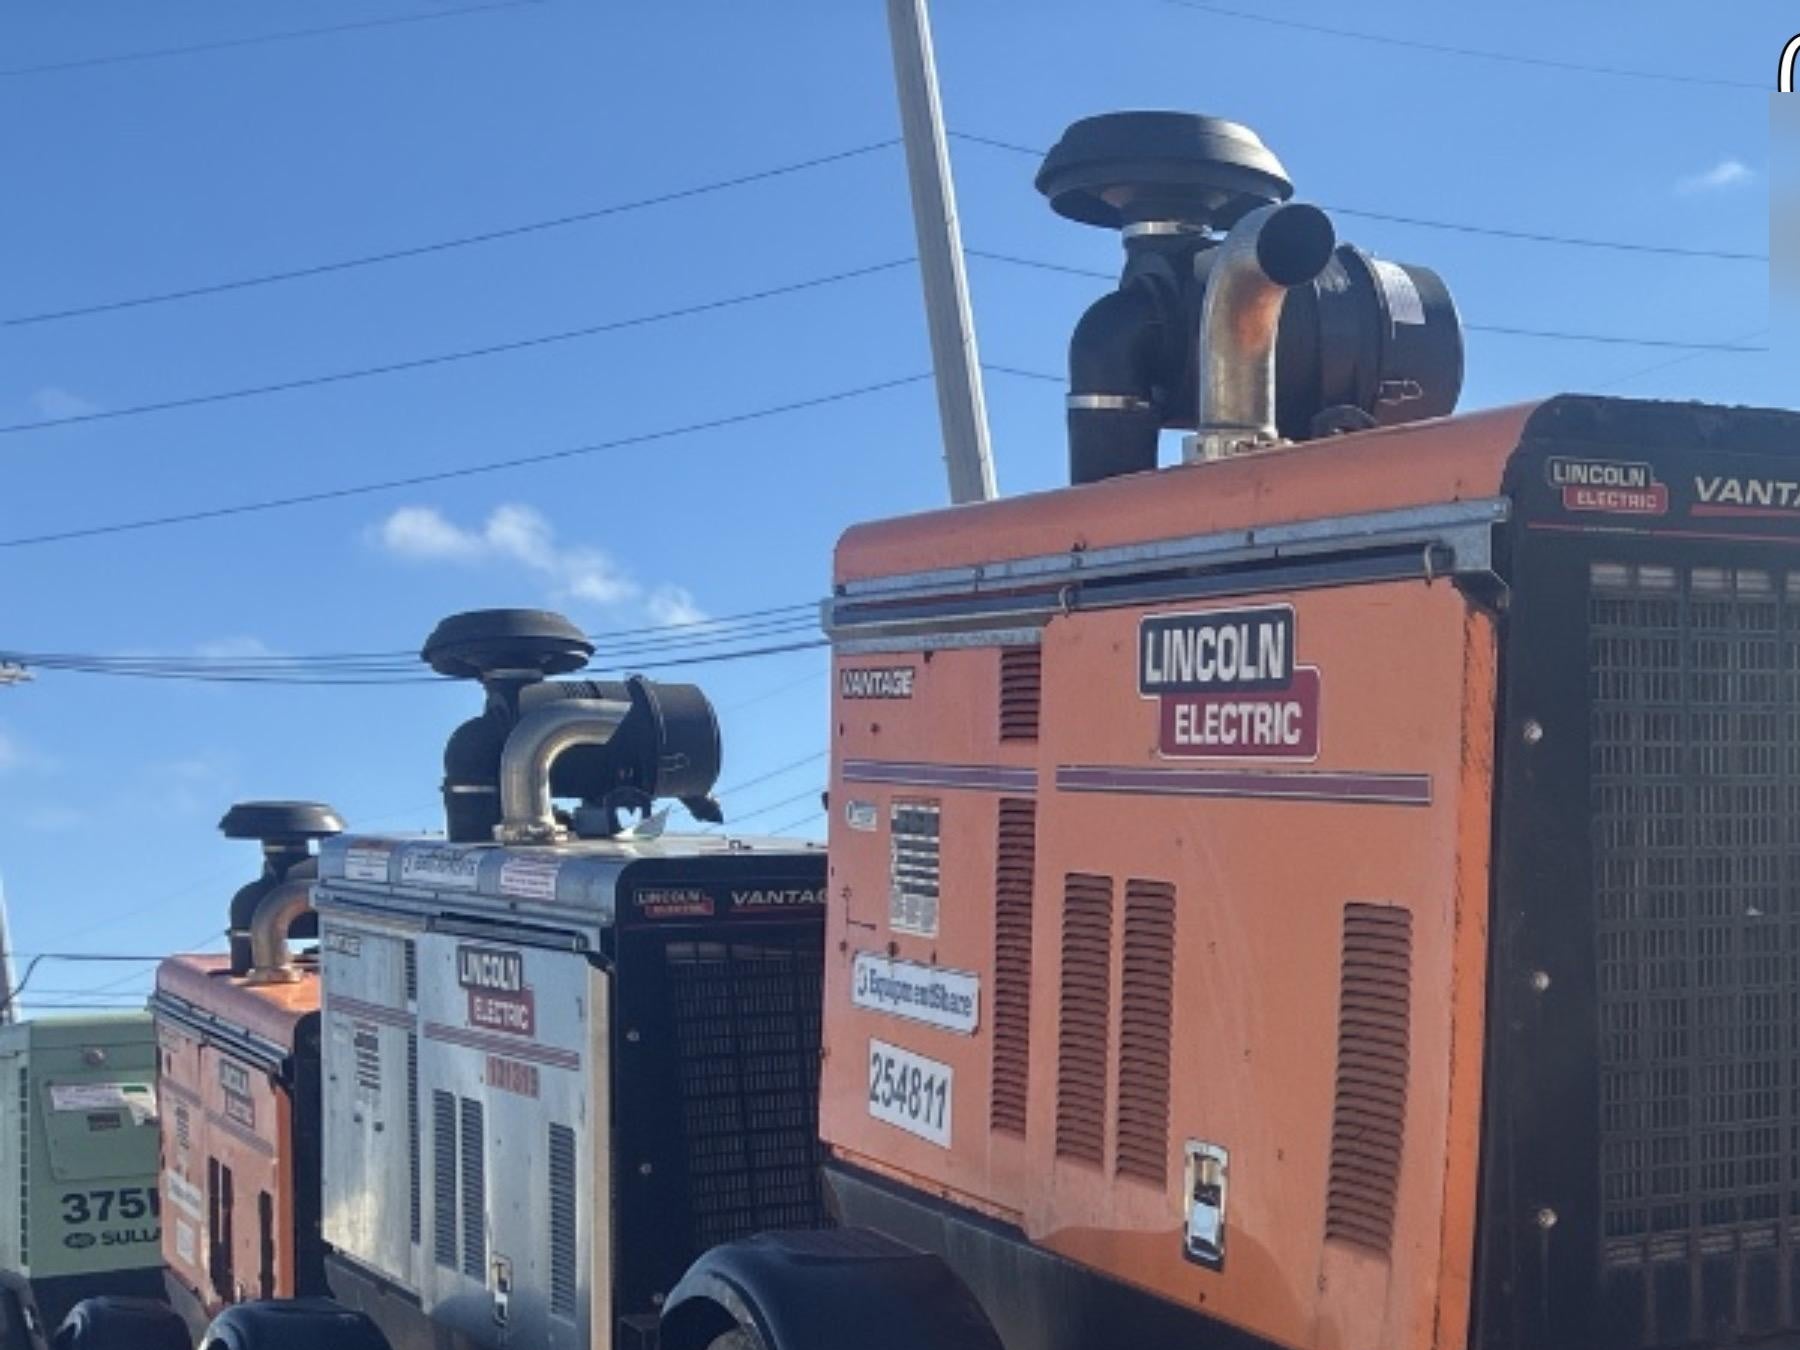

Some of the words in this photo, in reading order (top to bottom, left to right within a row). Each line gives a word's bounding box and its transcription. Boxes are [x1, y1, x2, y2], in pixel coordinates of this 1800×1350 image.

[1553, 463, 1646, 487] LINCOLN
[1576, 490, 1657, 508] ELECTRIC
[1145, 620, 1286, 684] LINCOLN
[841, 667, 915, 697] VANTAGE
[1174, 702, 1303, 745] ELECTRIC
[460, 949, 521, 992] LINCOLN
[472, 995, 530, 1030] ELECTRIC
[869, 1052, 949, 1129] 254811
